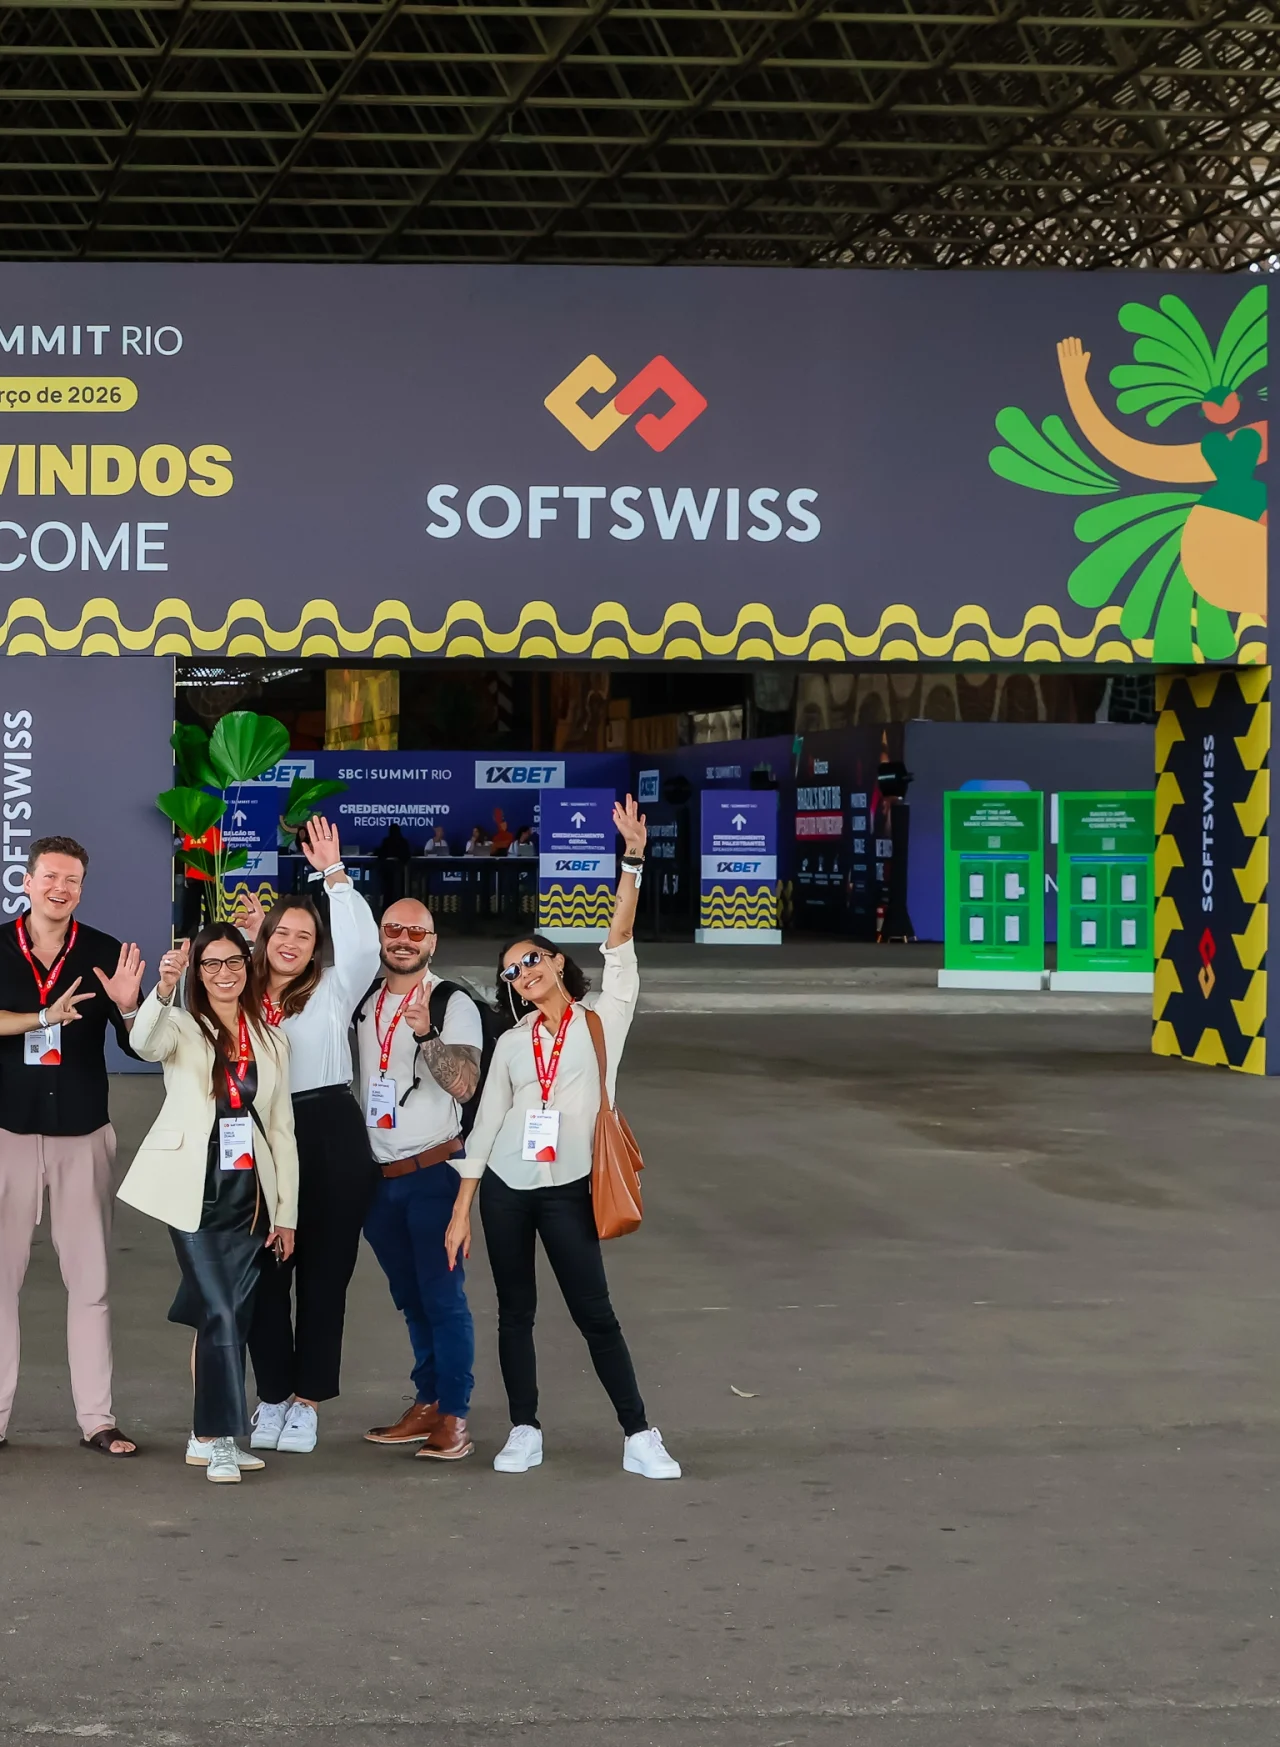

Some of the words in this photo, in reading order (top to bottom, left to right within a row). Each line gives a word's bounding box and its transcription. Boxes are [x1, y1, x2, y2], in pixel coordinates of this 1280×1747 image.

[122, 325, 184, 356] RIO
[37, 385, 62, 403] de
[67, 386, 122, 404] 2026
[425, 483, 822, 543] SOFTSWISS
[254, 765, 307, 782] BET
[338, 768, 363, 780] SBC
[370, 768, 428, 780] SUMMIT
[431, 769, 452, 780] RIO
[485, 766, 557, 783] 1XBET
[1, 708, 34, 915] SOFTSWISS
[339, 804, 450, 815] CREDENCIAMENTO
[354, 816, 434, 827] REGISTRATION
[1201, 733, 1215, 912] SOFTSWISS
[555, 860, 600, 871] 1XBET
[716, 862, 761, 873] 1XBET
